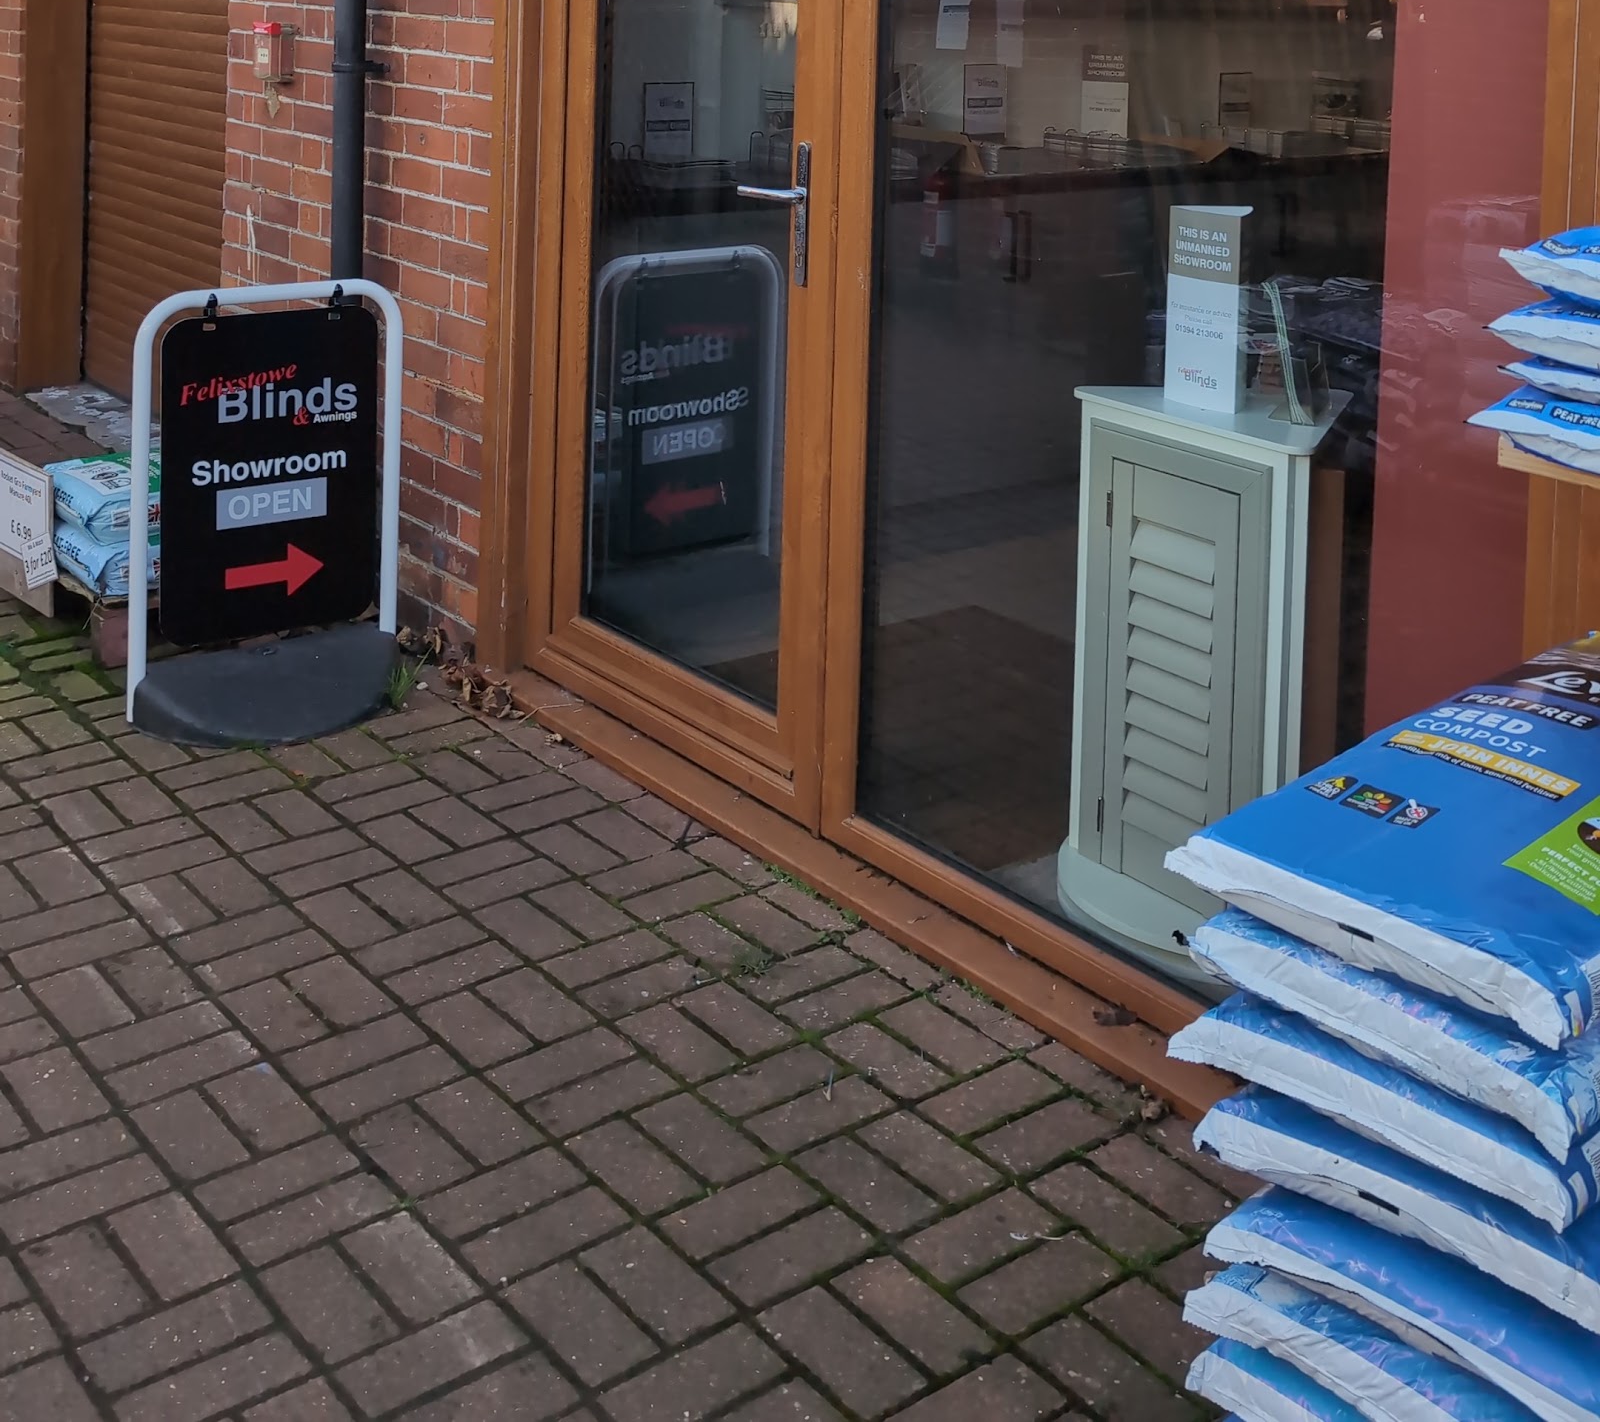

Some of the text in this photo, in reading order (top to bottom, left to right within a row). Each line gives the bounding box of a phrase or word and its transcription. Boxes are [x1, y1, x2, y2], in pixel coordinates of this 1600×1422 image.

[1175, 239, 1230, 257] UNMANNED
[1178, 225, 1227, 243] THIS IS AN
[1173, 253, 1232, 272] SHOWROOM
[1175, 324, 1224, 340] 01394 213006
[180, 363, 298, 407] Felixstowe
[1184, 371, 1218, 387] Blinds
[218, 377, 358, 424] Blinds
[292, 406, 358, 426] & Awnings
[1553, 407, 1581, 423] PEAT
[191, 449, 347, 487] Showroom
[228, 486, 312, 520] OPEN
[1430, 706, 1534, 735] SEED
[1461, 693, 1593, 727] PEAT FREE
[1413, 718, 1547, 758] COMPOST
[1428, 740, 1572, 793] JOHN INNES
[1435, 751, 1451, 761] mix
[1450, 757, 1463, 765] of
[1505, 774, 1522, 785] and
[1541, 846, 1590, 877] PERFECT
